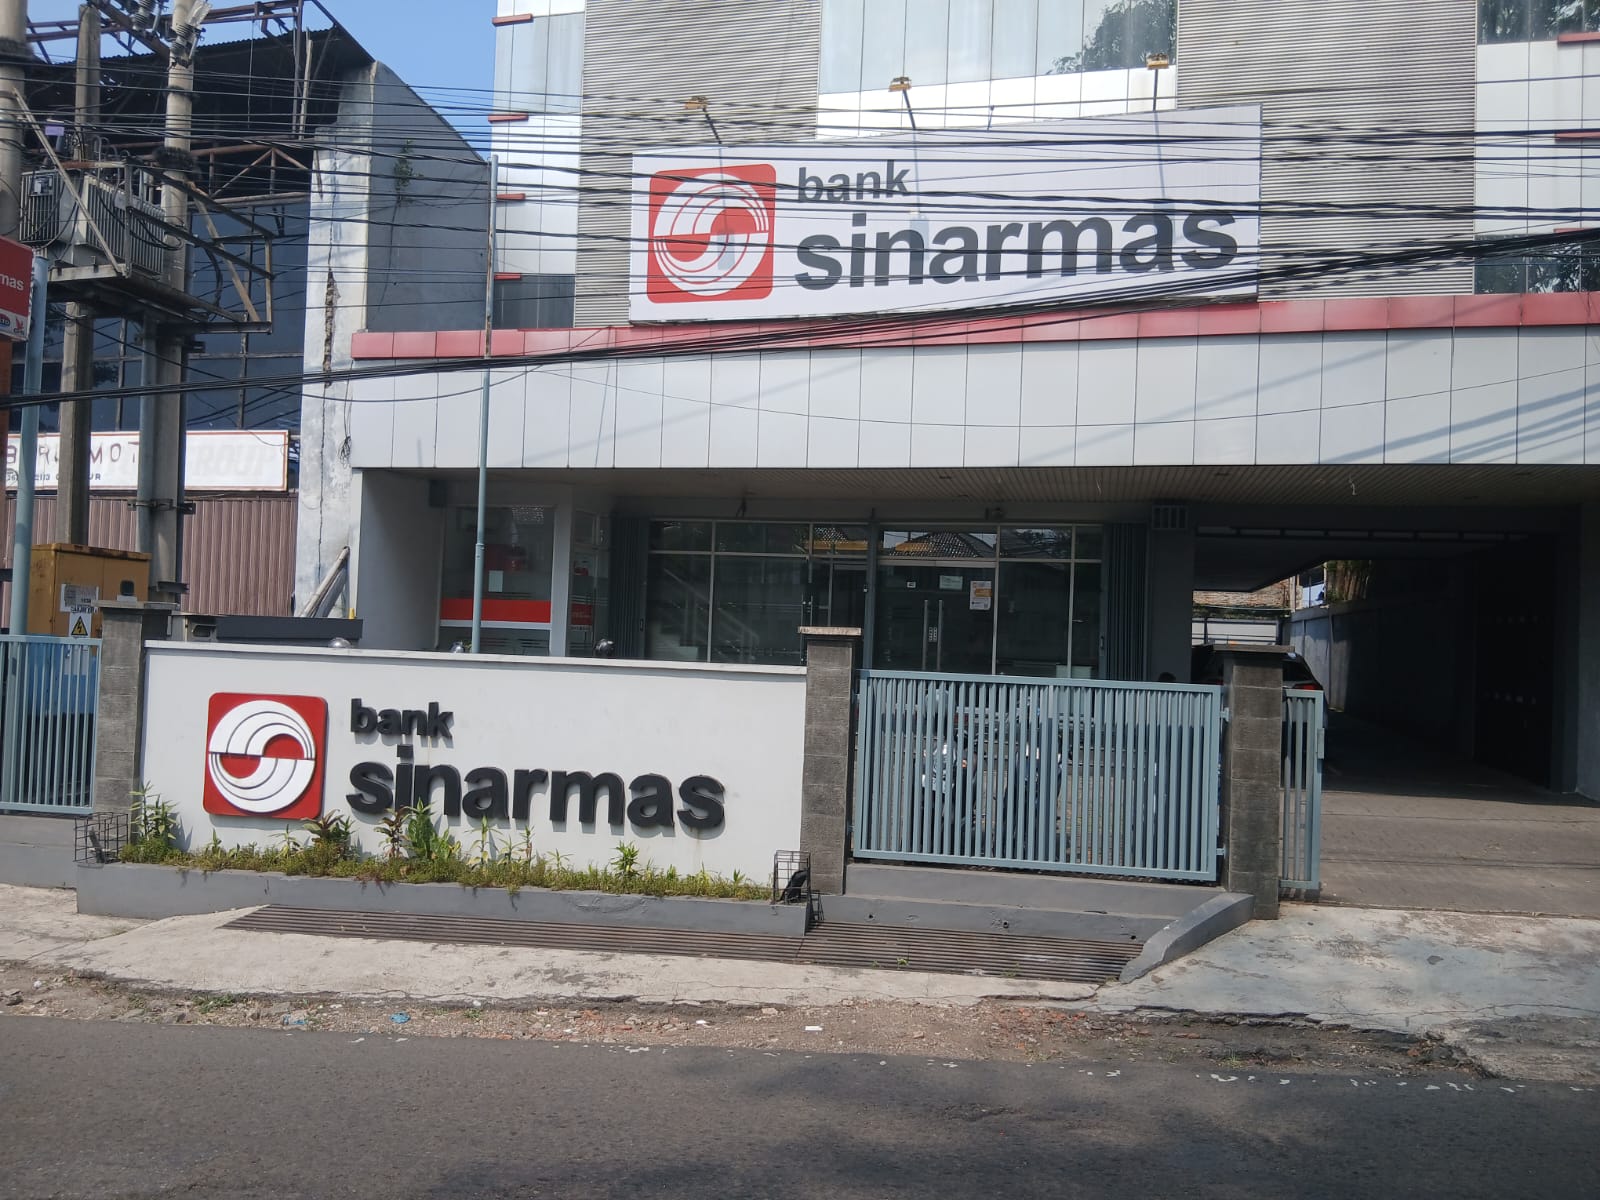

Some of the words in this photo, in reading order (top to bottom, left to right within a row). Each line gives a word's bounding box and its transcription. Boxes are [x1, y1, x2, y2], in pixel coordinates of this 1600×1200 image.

[798, 160, 912, 204] bank
[795, 208, 1238, 291] sinarmas
[350, 698, 454, 739] bank
[346, 744, 727, 834] sinarmas
